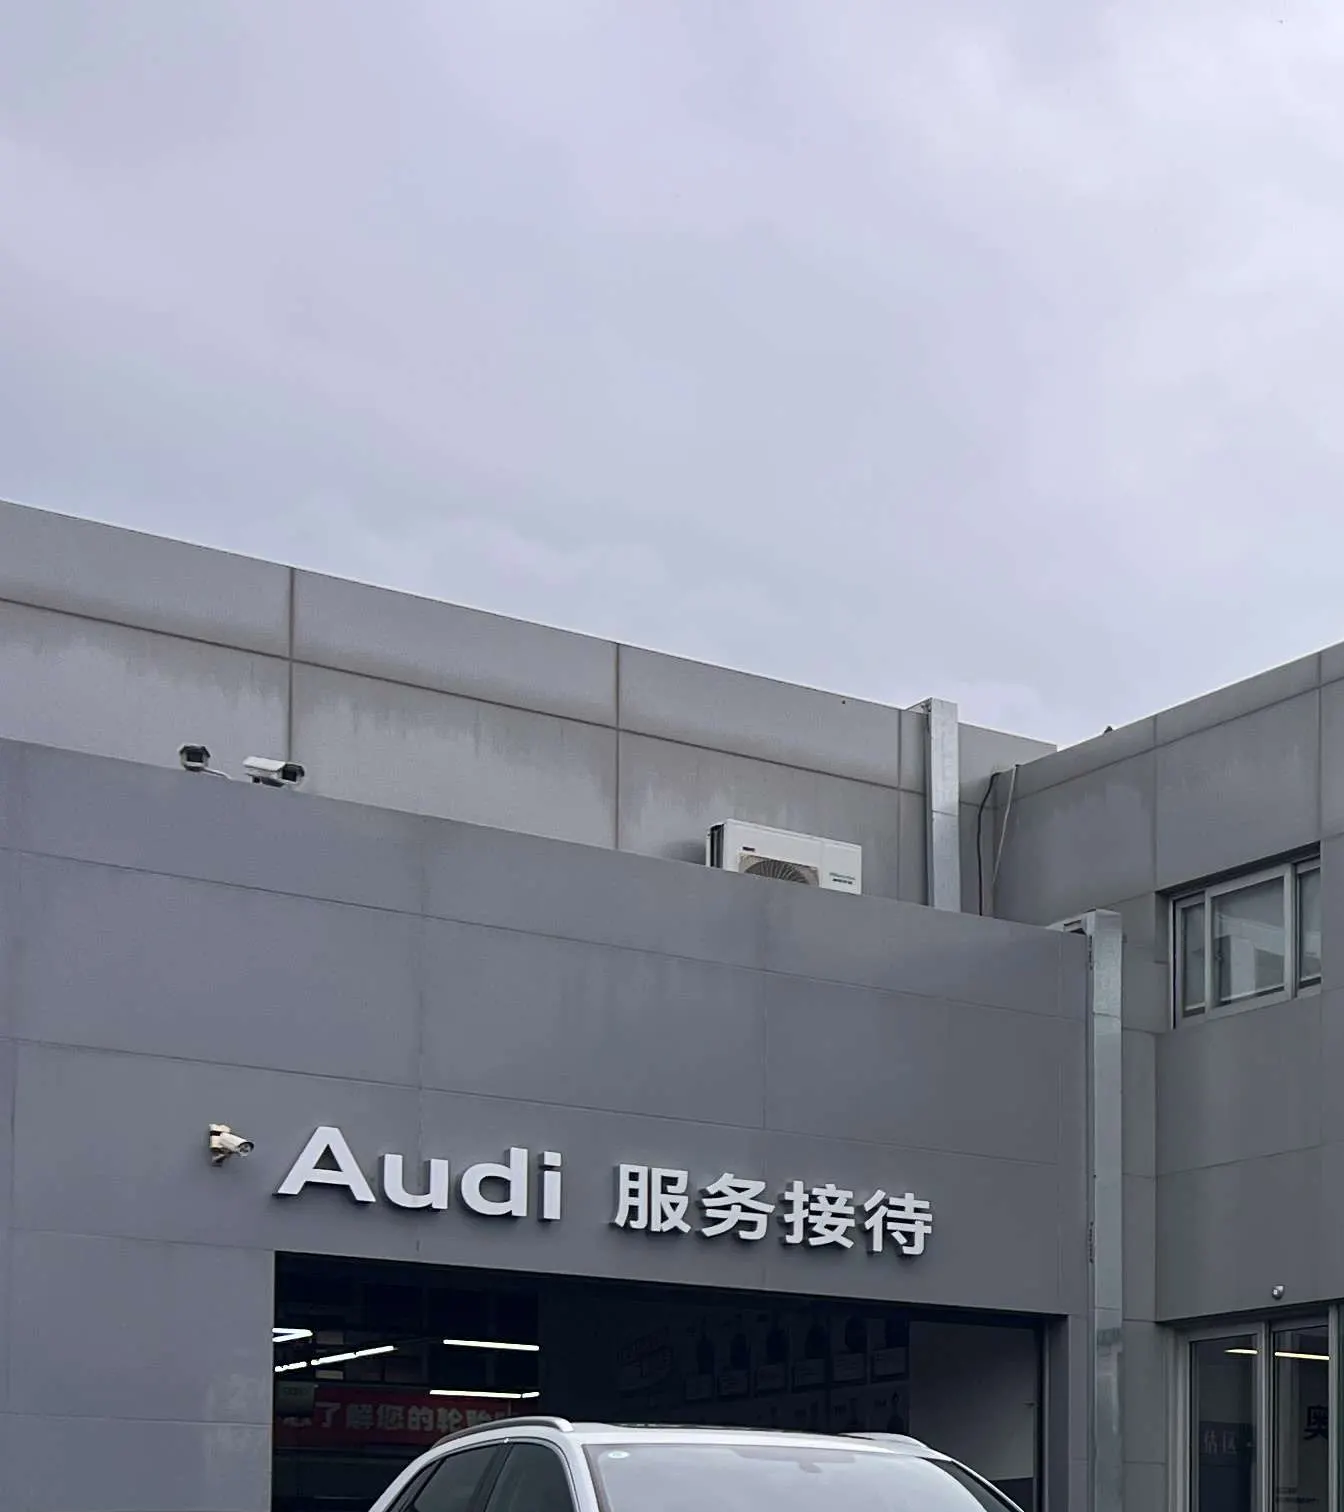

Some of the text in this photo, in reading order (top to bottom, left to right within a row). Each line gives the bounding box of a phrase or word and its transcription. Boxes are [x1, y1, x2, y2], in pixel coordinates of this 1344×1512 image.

[276, 1125, 933, 1256] Audi 服务接待
